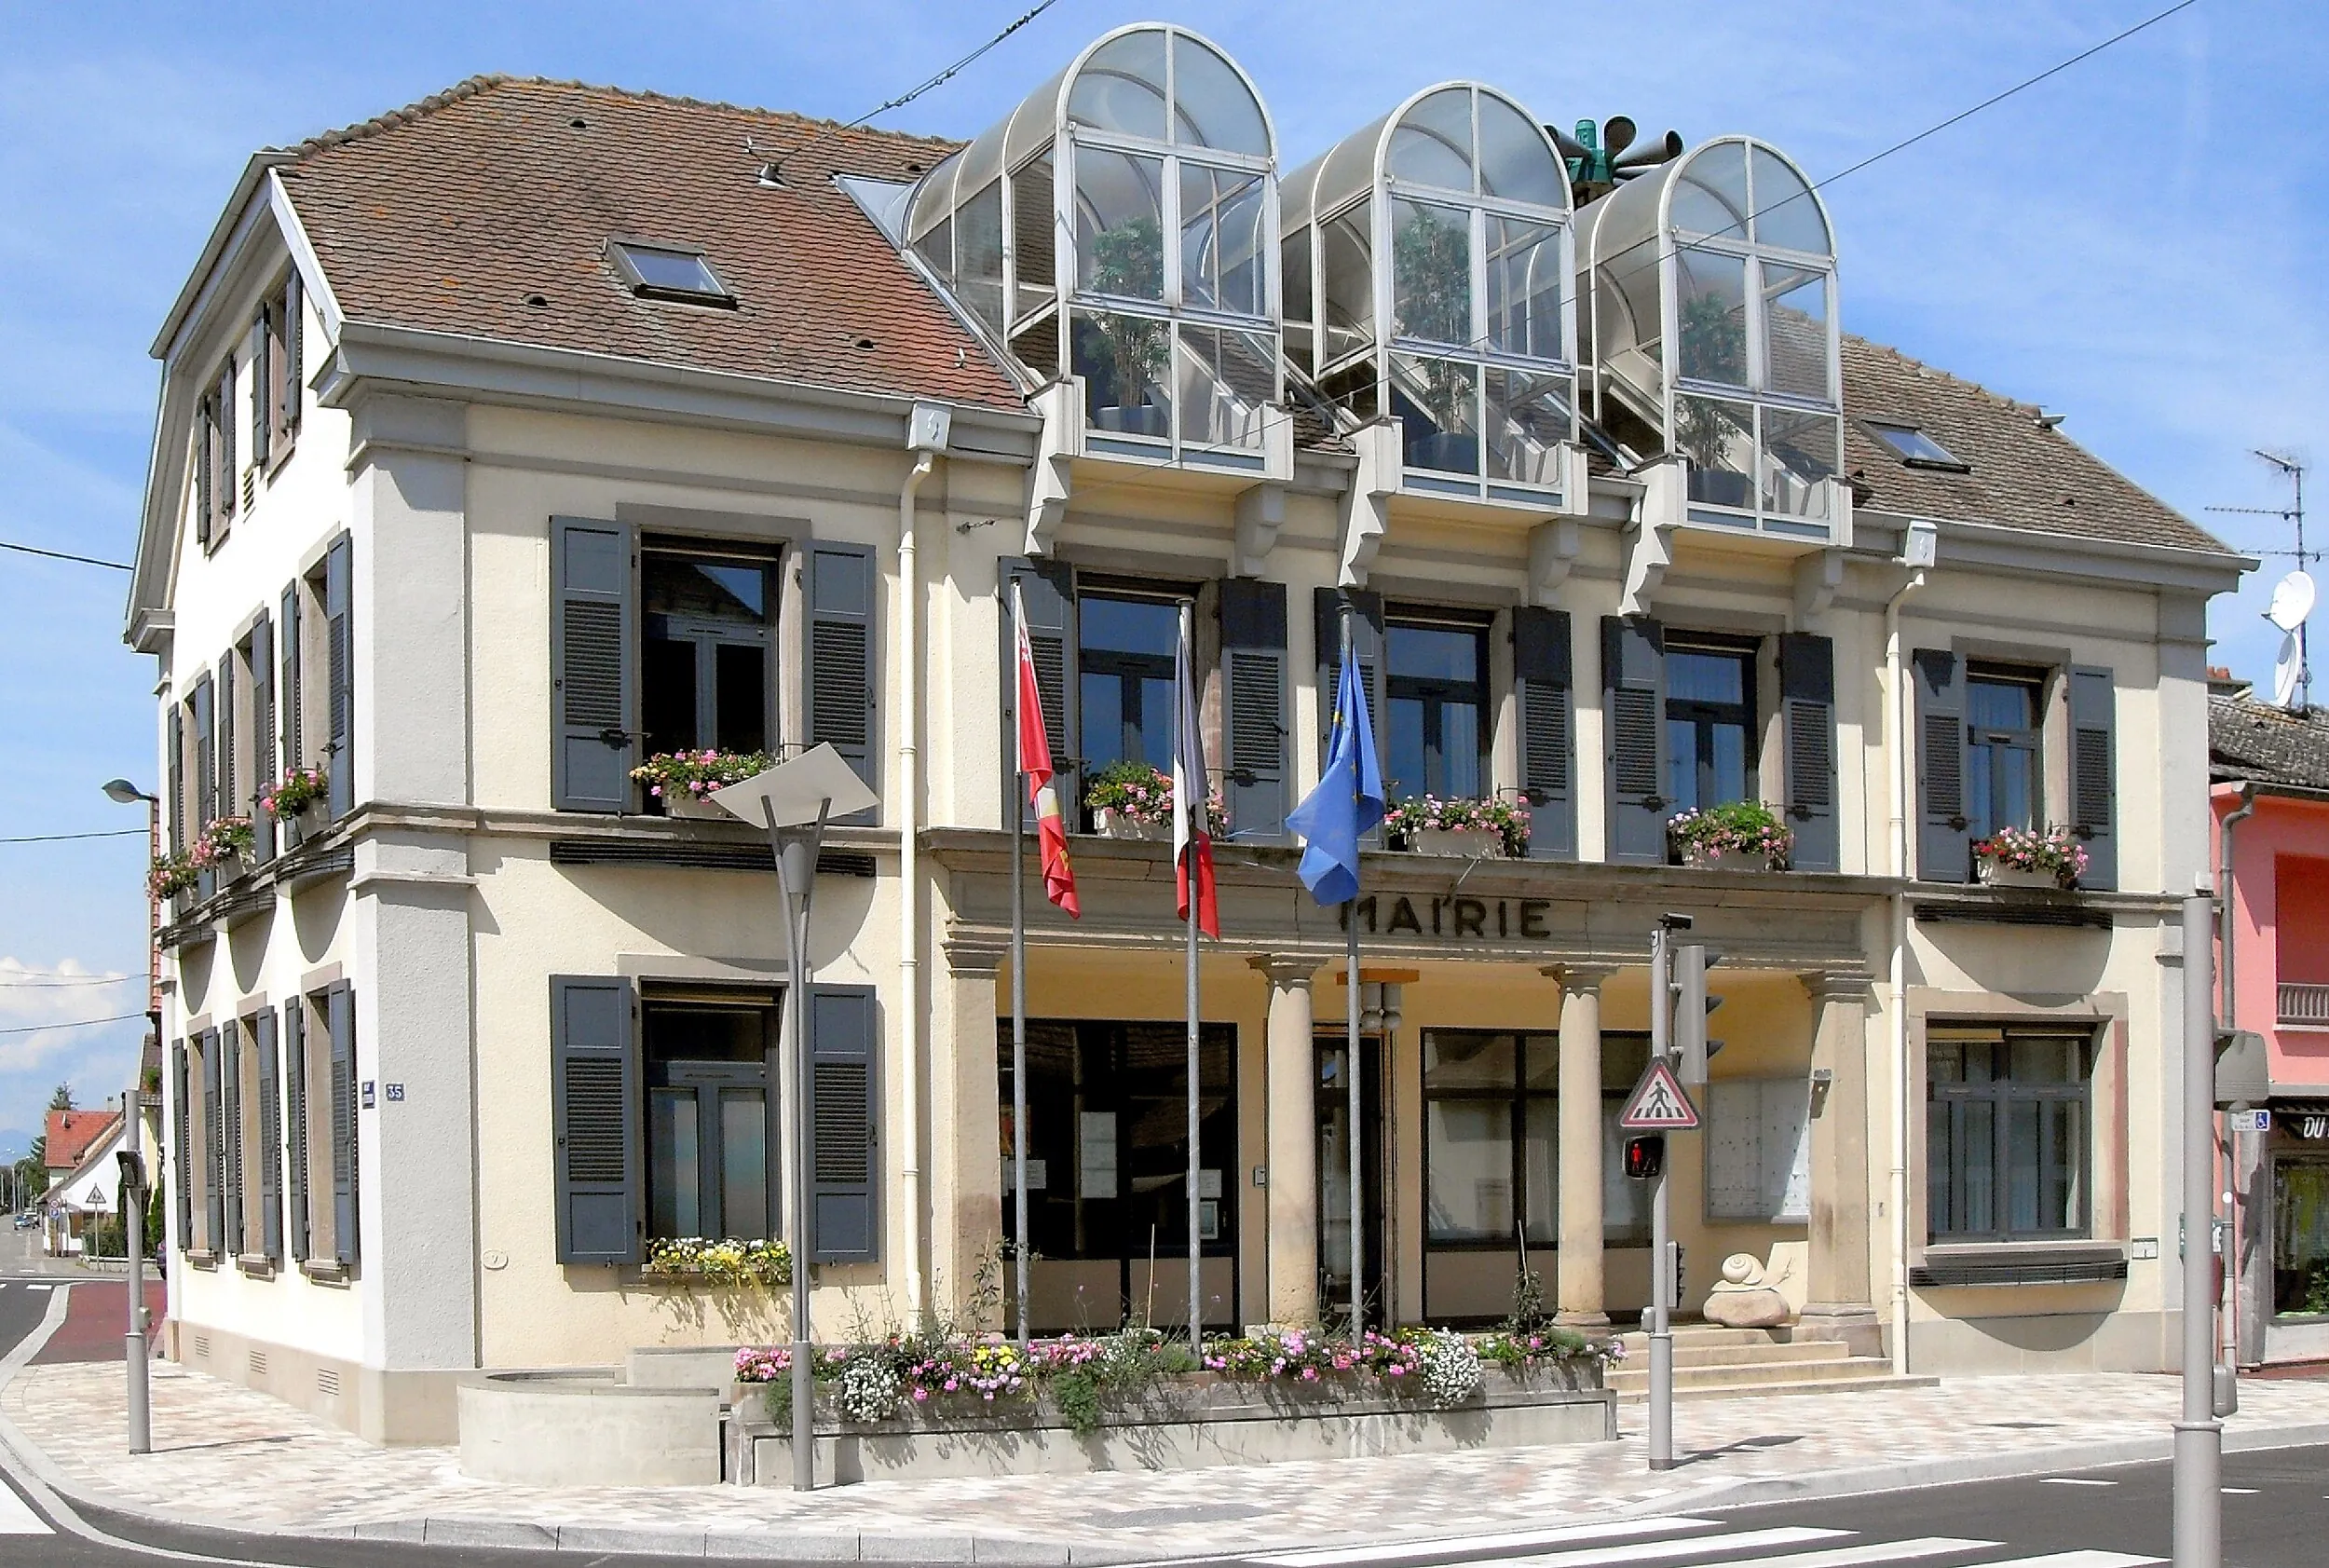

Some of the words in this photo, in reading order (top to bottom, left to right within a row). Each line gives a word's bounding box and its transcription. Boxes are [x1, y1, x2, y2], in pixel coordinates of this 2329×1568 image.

[1340, 896, 1551, 937] MAIRIE
[388, 1085, 402, 1098] 35
[2304, 1117, 2325, 1138] DU
